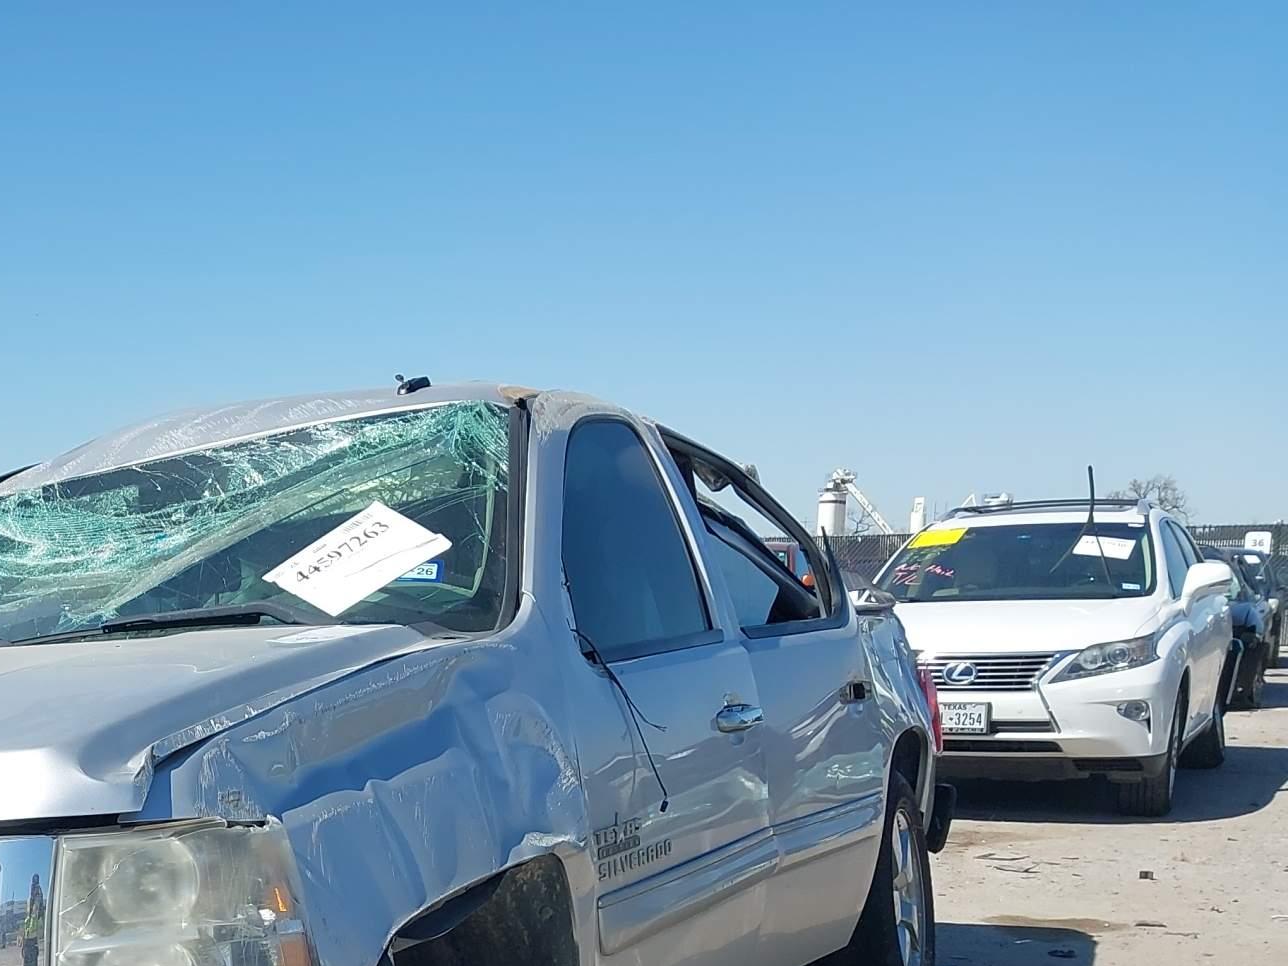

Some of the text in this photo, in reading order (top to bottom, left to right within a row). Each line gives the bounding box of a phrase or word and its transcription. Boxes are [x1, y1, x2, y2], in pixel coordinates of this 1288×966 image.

[295, 521, 390, 584] 44597263
[1251, 538, 1265, 548] 36
[598, 838, 672, 881] SILVERADO
